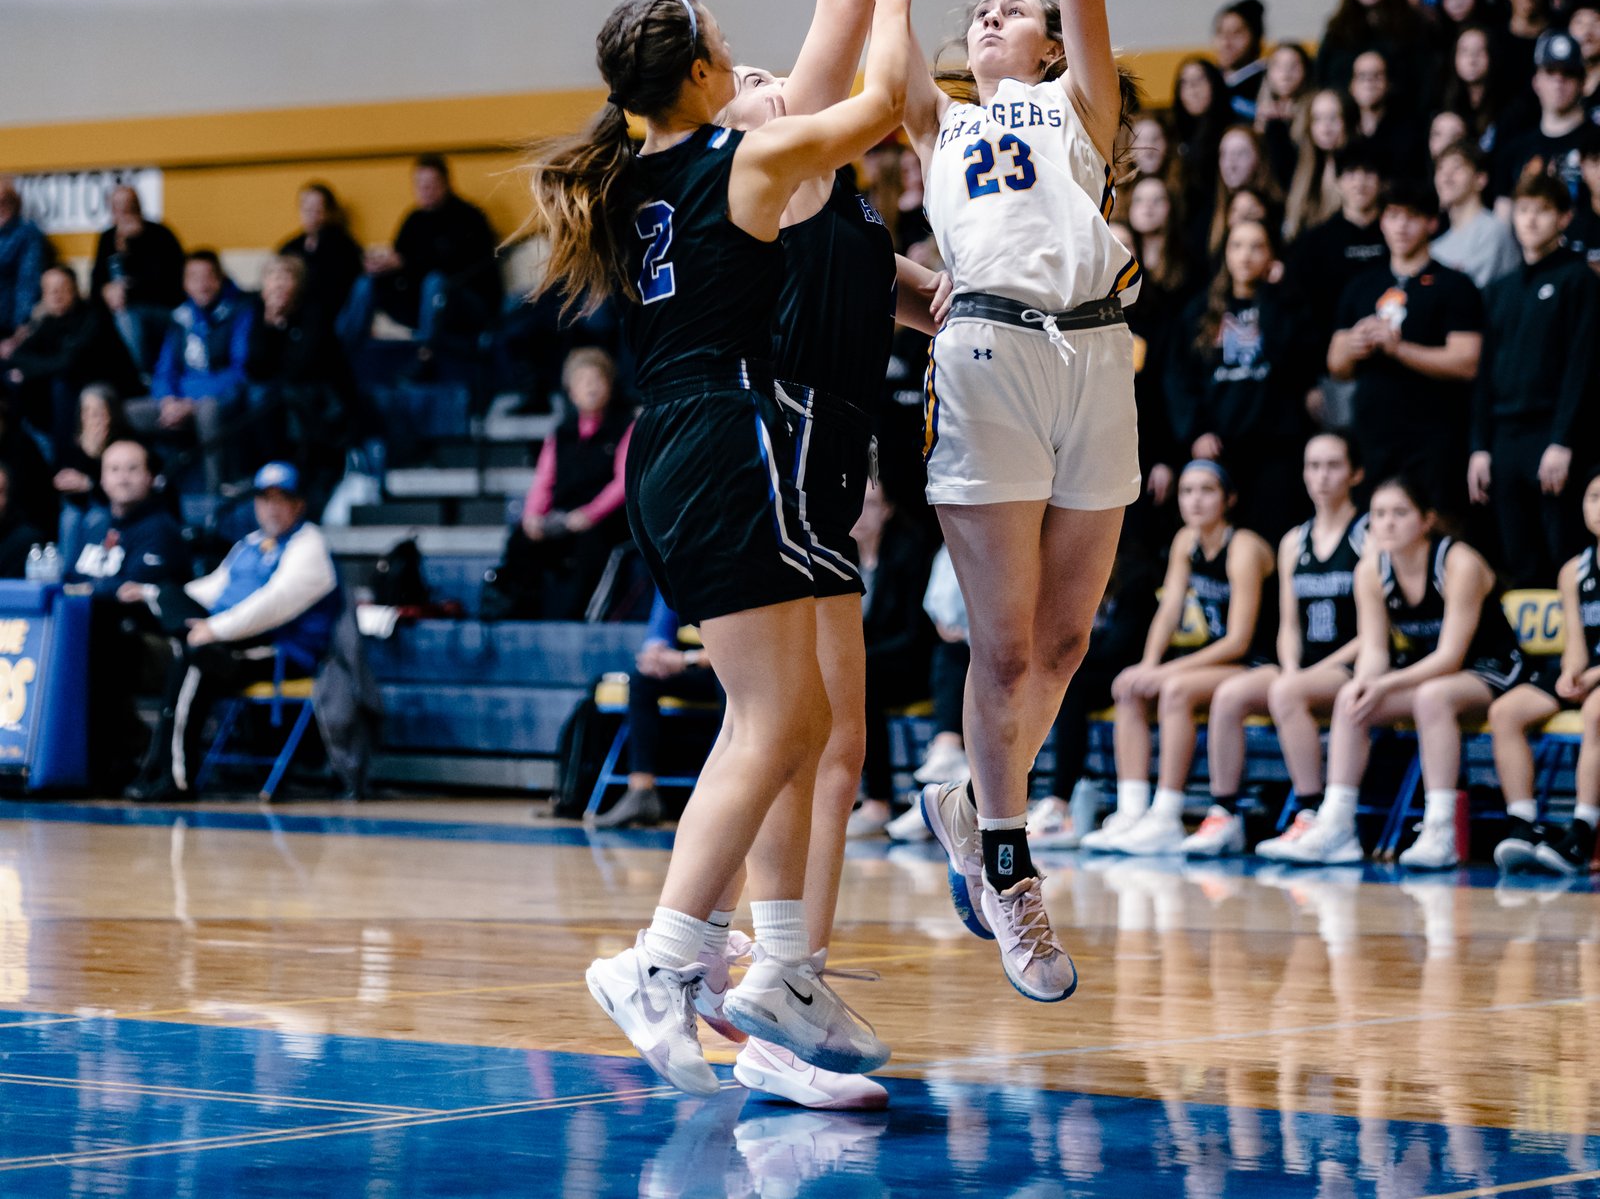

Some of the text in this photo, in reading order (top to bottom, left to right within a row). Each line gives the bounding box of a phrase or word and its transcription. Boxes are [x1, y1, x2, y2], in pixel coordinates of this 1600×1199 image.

[940, 101, 1062, 151] CHAGERS
[963, 133, 1037, 200] 23
[634, 200, 675, 305] 2
